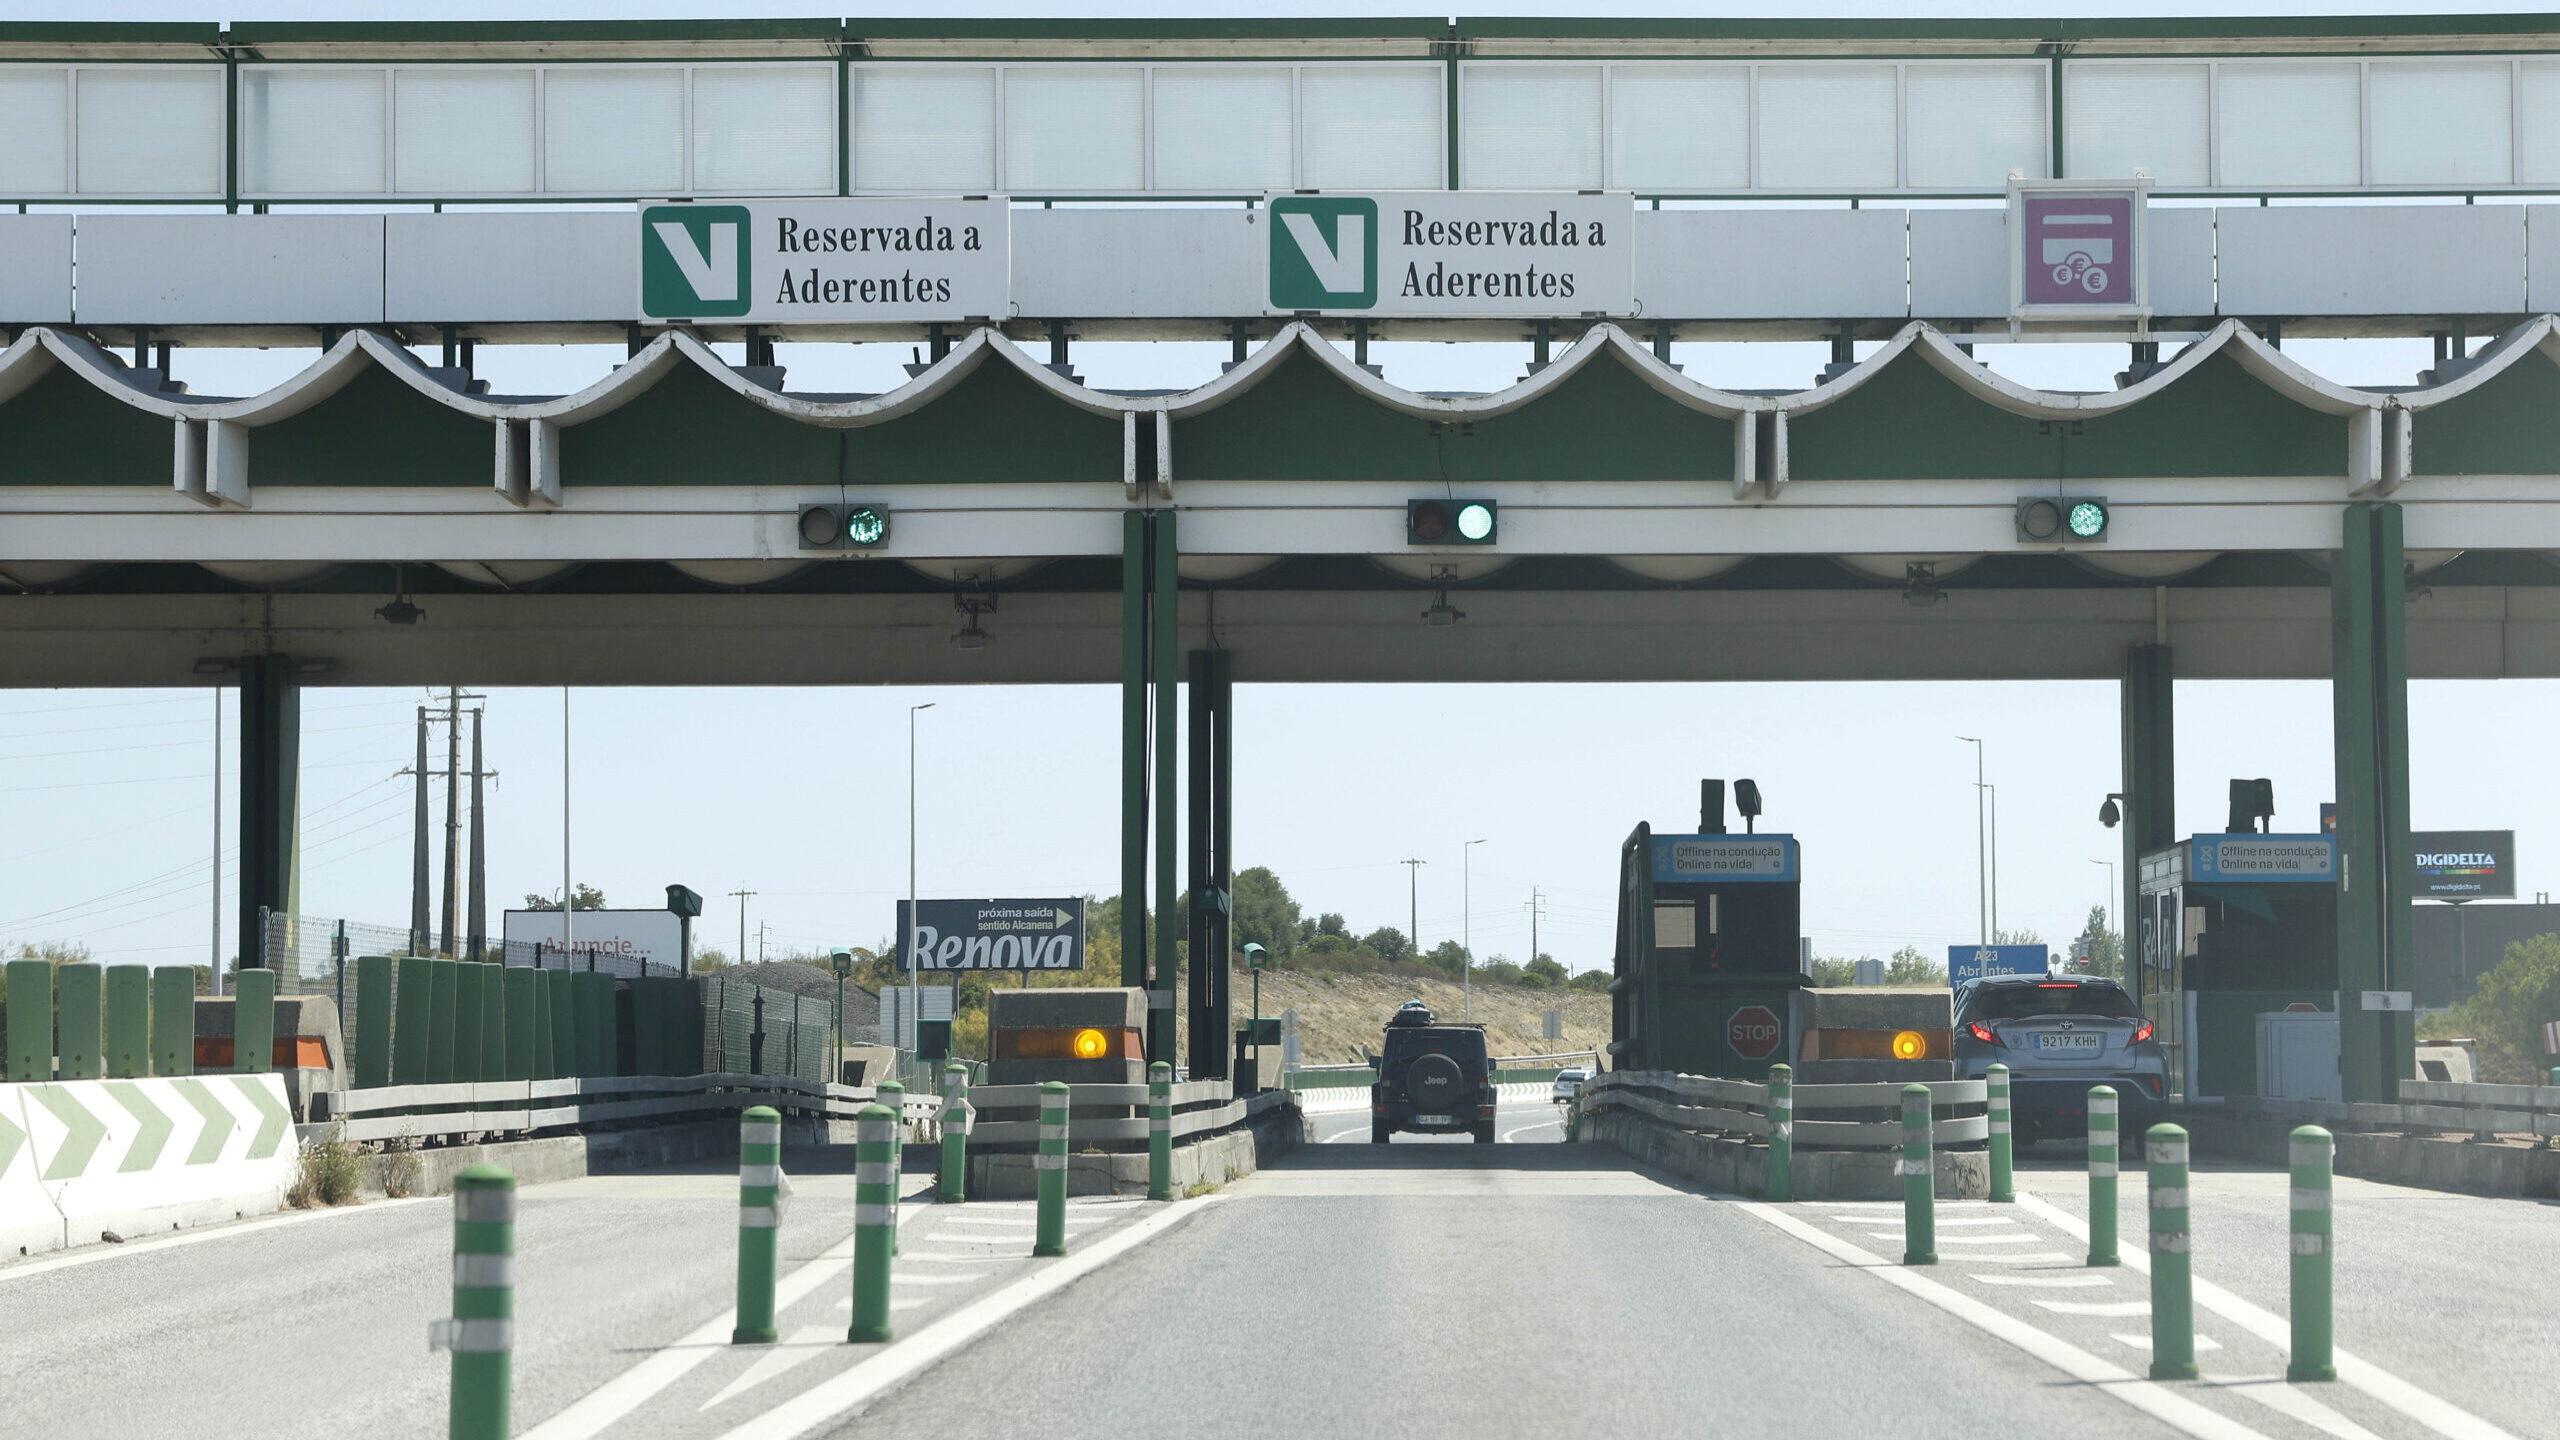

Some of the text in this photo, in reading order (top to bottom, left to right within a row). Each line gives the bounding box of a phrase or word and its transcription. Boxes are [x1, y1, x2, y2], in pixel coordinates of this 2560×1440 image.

[777, 215, 982, 253] Reservada a
[1402, 209, 1607, 247] Reservada a
[775, 267, 951, 304] Aderentes
[1400, 260, 1575, 298] Aderentes
[1676, 845, 1781, 860] Offline na condução
[2221, 845, 2327, 859] Offline na condução
[1676, 859, 1753, 870] Online na vida
[2221, 859, 2299, 870] Online na vida
[2415, 853, 2495, 866] DIGIDELTA
[978, 906, 1054, 920] próxima saída
[978, 920, 1054, 931] sentido Alcanena
[906, 925, 1073, 969] Renova
[1958, 965, 2015, 977] Abrntes
[1732, 1024, 1777, 1041] STOP
[2042, 1036, 2097, 1047] 9217 KHH
[1424, 1076, 1447, 1086] Jeep
